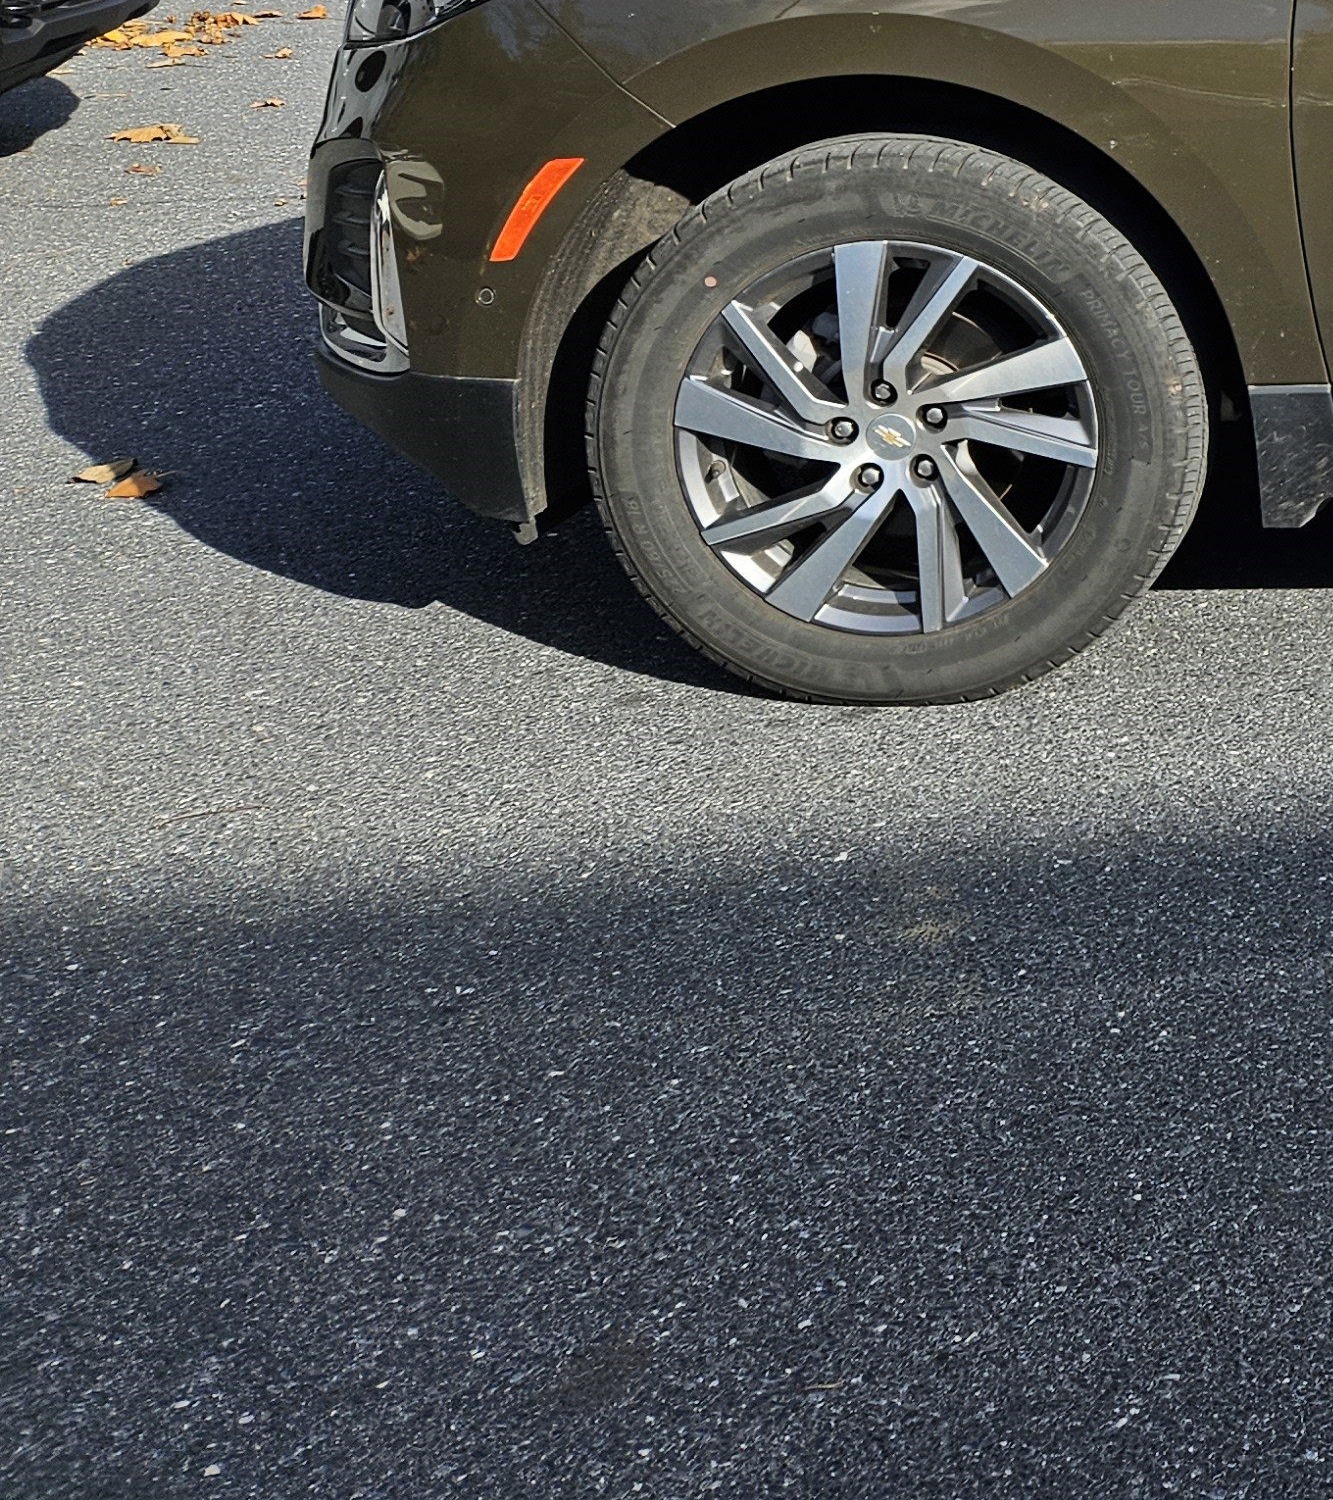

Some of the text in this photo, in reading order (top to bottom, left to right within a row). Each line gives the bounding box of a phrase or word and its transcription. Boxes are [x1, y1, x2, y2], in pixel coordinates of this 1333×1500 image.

[1079, 289, 1132, 364] PRIMACY
[1123, 368, 1147, 415] TOUR
[631, 522, 649, 535] R
